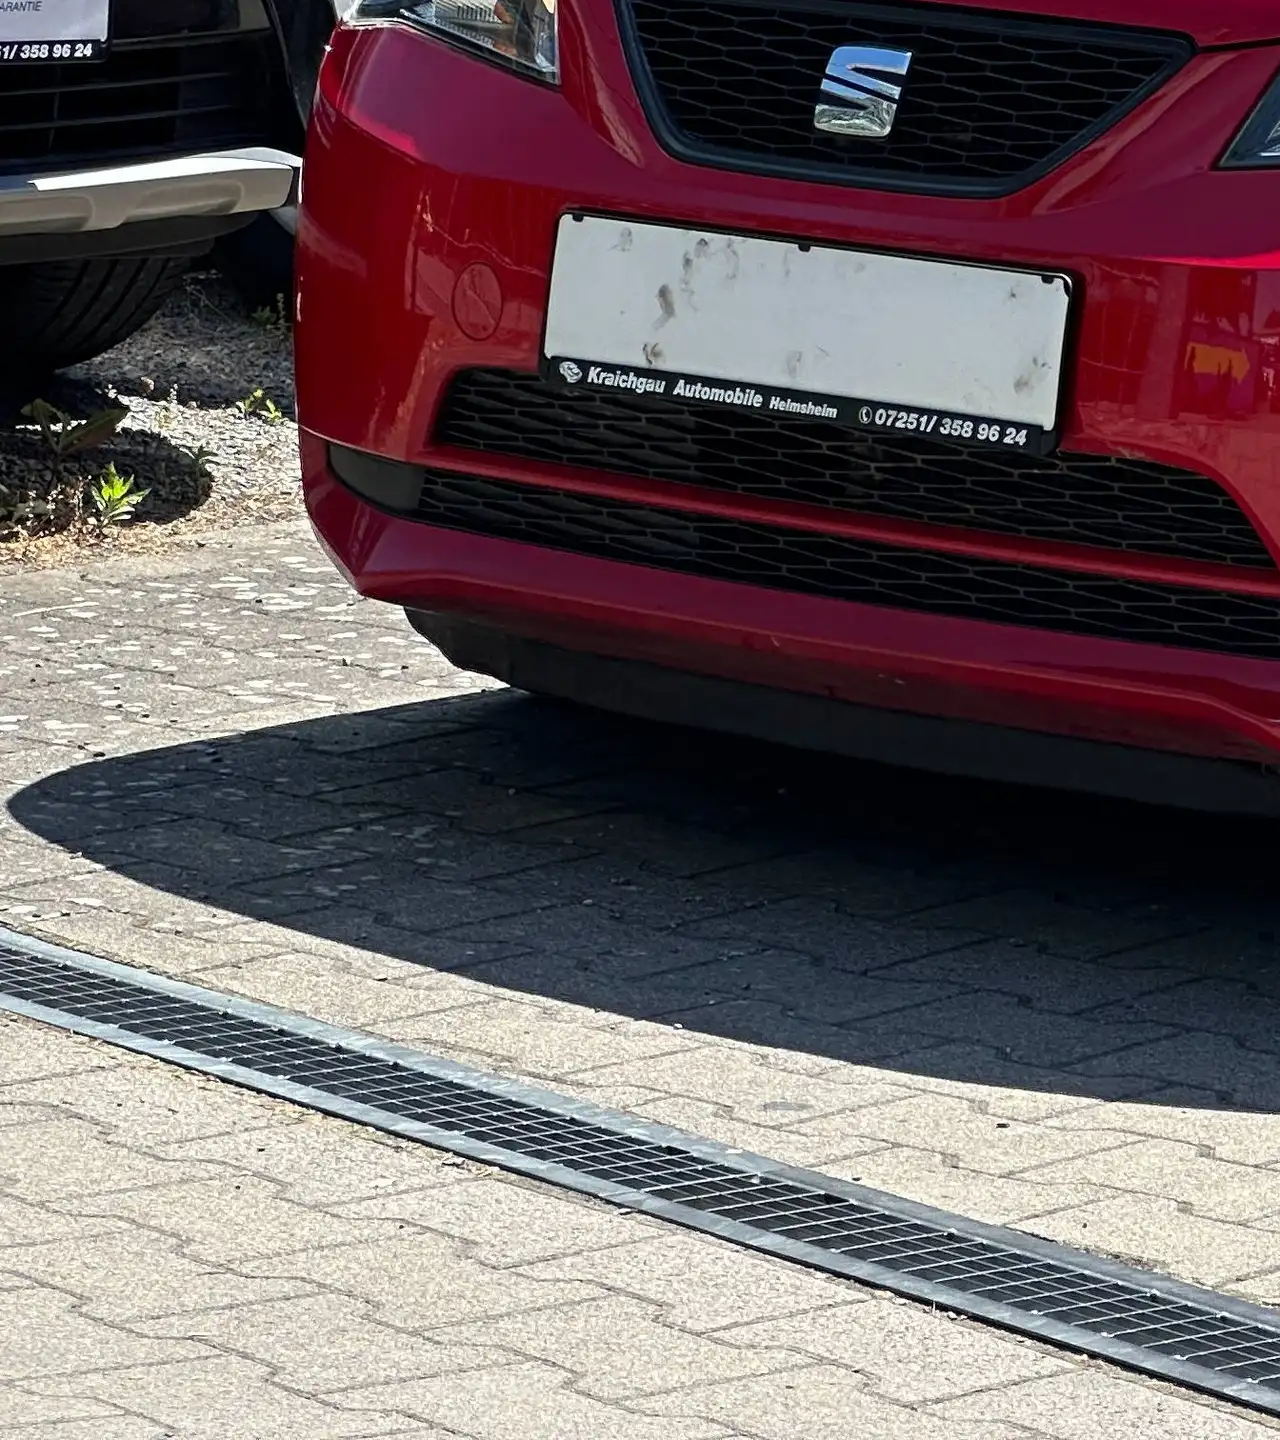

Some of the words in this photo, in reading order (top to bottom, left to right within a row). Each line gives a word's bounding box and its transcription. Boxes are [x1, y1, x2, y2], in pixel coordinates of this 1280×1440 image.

[20, 44, 49, 59] 358
[52, 44, 71, 58] 96
[74, 43, 92, 57] 24
[587, 366, 666, 394] Kraichgau
[673, 379, 764, 407] Automobile
[874, 409, 938, 432] 07251/
[939, 418, 973, 438] 358
[977, 424, 1000, 442] 96
[1003, 428, 1028, 446] 24
